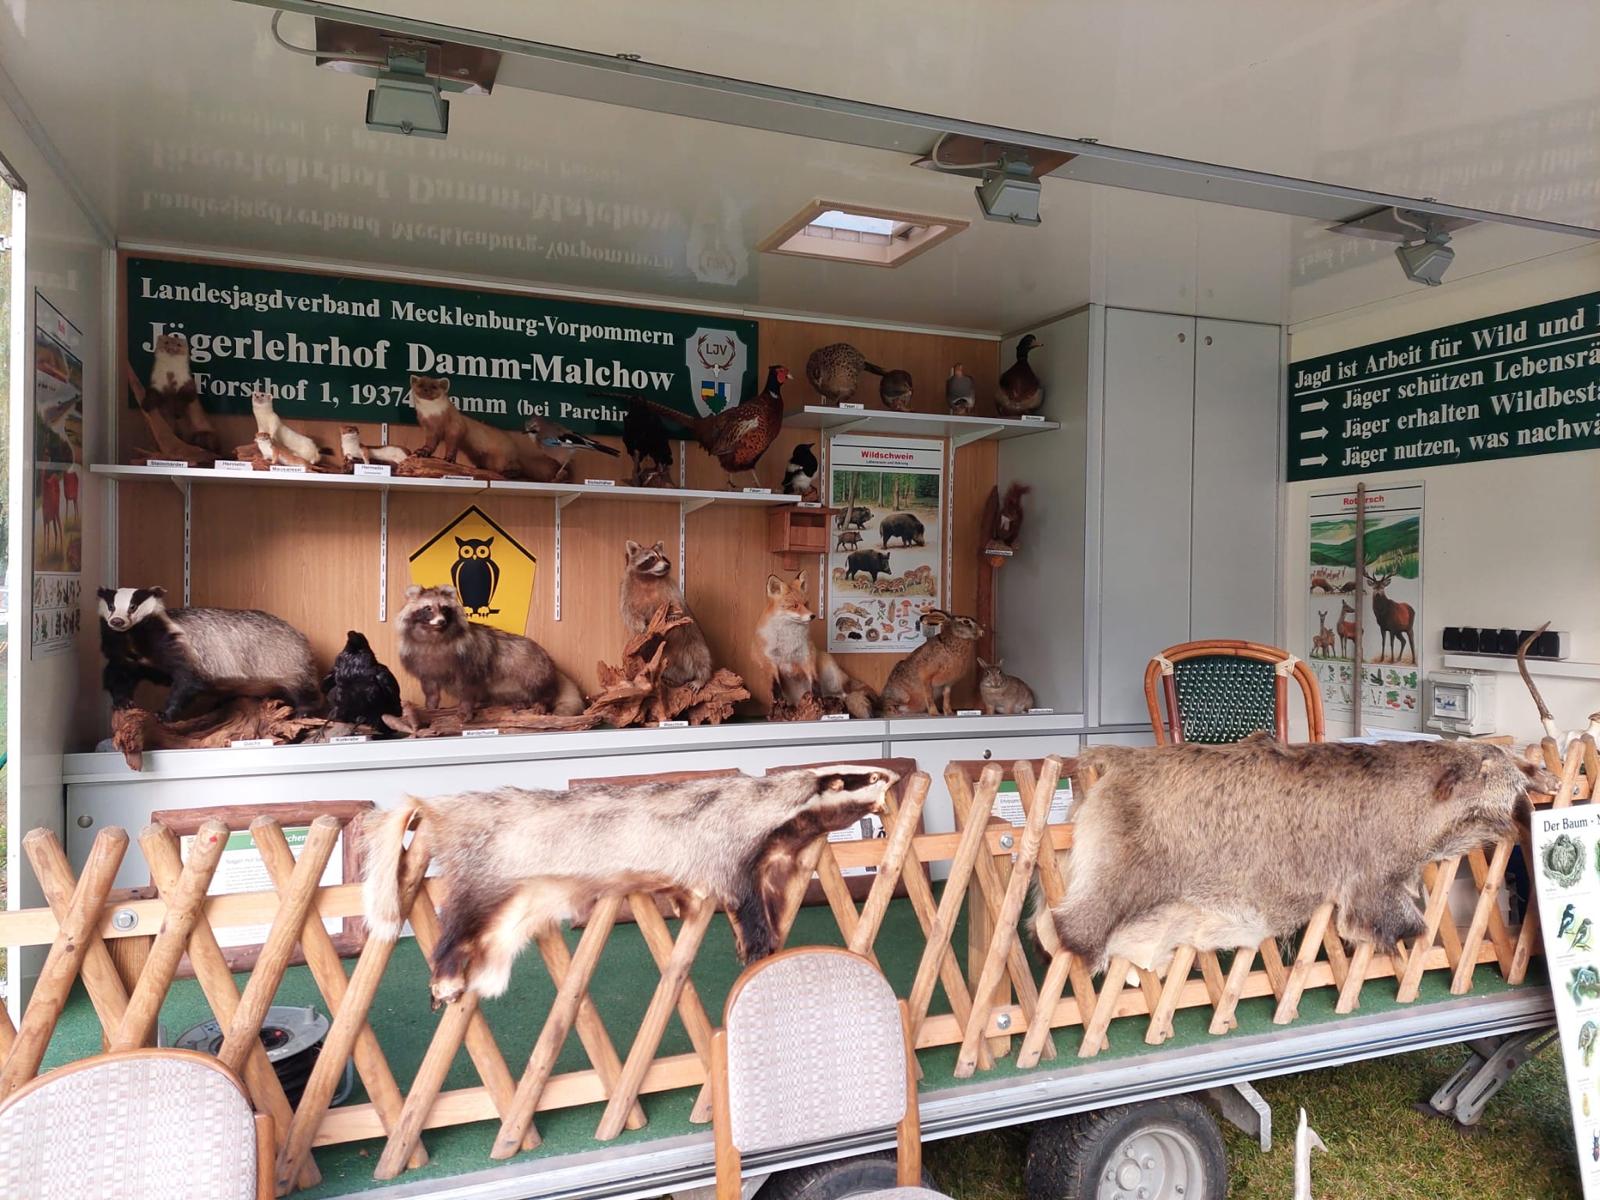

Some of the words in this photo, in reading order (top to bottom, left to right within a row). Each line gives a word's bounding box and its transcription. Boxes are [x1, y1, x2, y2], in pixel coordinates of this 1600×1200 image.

[140, 277, 380, 318] Landesjagdverband
[391, 299, 675, 346] Mecklenburg-Vorpommern
[406, 342, 675, 391] Damm-Malchow
[705, 343, 728, 355] LJV
[1295, 364, 1331, 389] Jagd
[1338, 360, 1358, 380] ist
[1365, 344, 1422, 375] Arbeit
[1430, 337, 1463, 361] für
[1471, 320, 1528, 351] Wild
[1538, 307, 1585, 338] und
[192, 372, 308, 402] Forsthof
[320, 381, 339, 408] 1,
[349, 383, 415, 409] 19374
[446, 395, 508, 414] amm
[517, 399, 549, 417] (bei
[1342, 387, 1391, 410] Jäger
[1398, 368, 1484, 400] schützen
[1342, 416, 1391, 440] Jäger
[1397, 402, 1480, 430] erhalten
[1490, 380, 1600, 416] Wildbest
[861, 450, 914, 460] Wildschwein
[1341, 445, 1388, 467] Jäger
[1394, 436, 1461, 460] nutzen,
[1468, 430, 1509, 451] was
[1343, 495, 1384, 504] Rotrsch
[1543, 820, 1560, 833] Der
[1562, 817, 1588, 830] Baum
